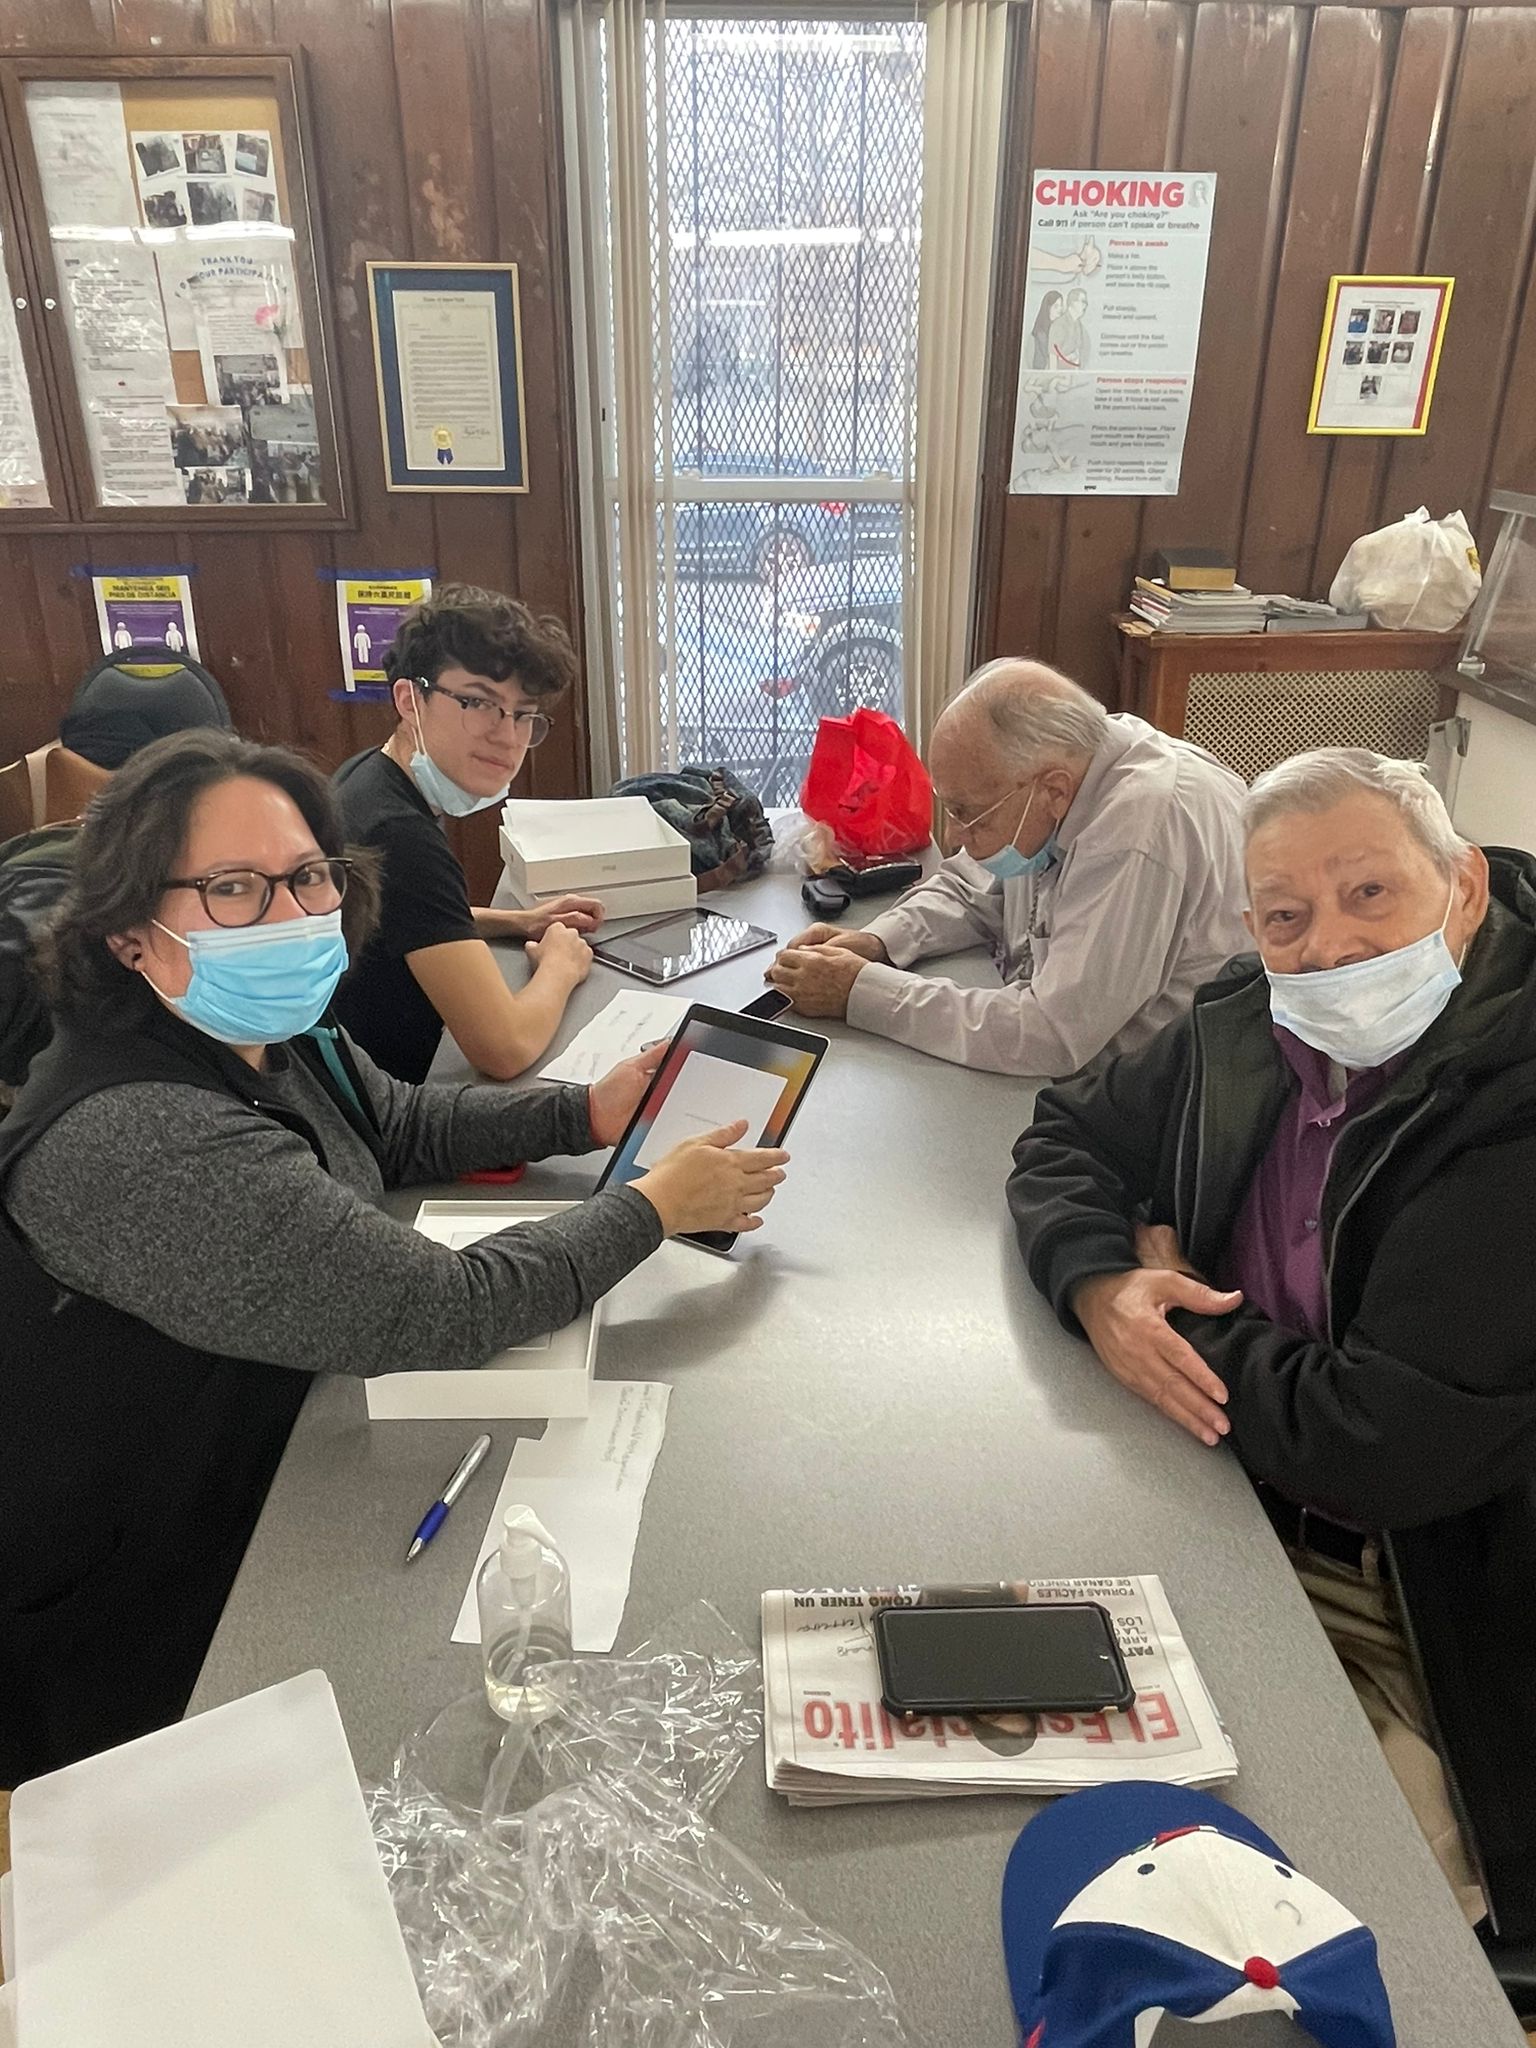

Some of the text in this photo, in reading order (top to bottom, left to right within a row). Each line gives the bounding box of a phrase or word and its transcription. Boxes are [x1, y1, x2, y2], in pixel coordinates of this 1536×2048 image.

[1035, 180, 1185, 208] CHOKING
[1073, 210, 1087, 218] Ask
[1111, 212, 1125, 220] you
[1038, 219, 1053, 227] Call
[1078, 222, 1106, 230] person
[1130, 222, 1154, 230] speak
[1168, 222, 1200, 230] breathe
[1087, 1587, 1135, 1597] FORMAS
[794, 1596, 913, 1608] COMO TENER UN
[1117, 1616, 1143, 1626] LOS
